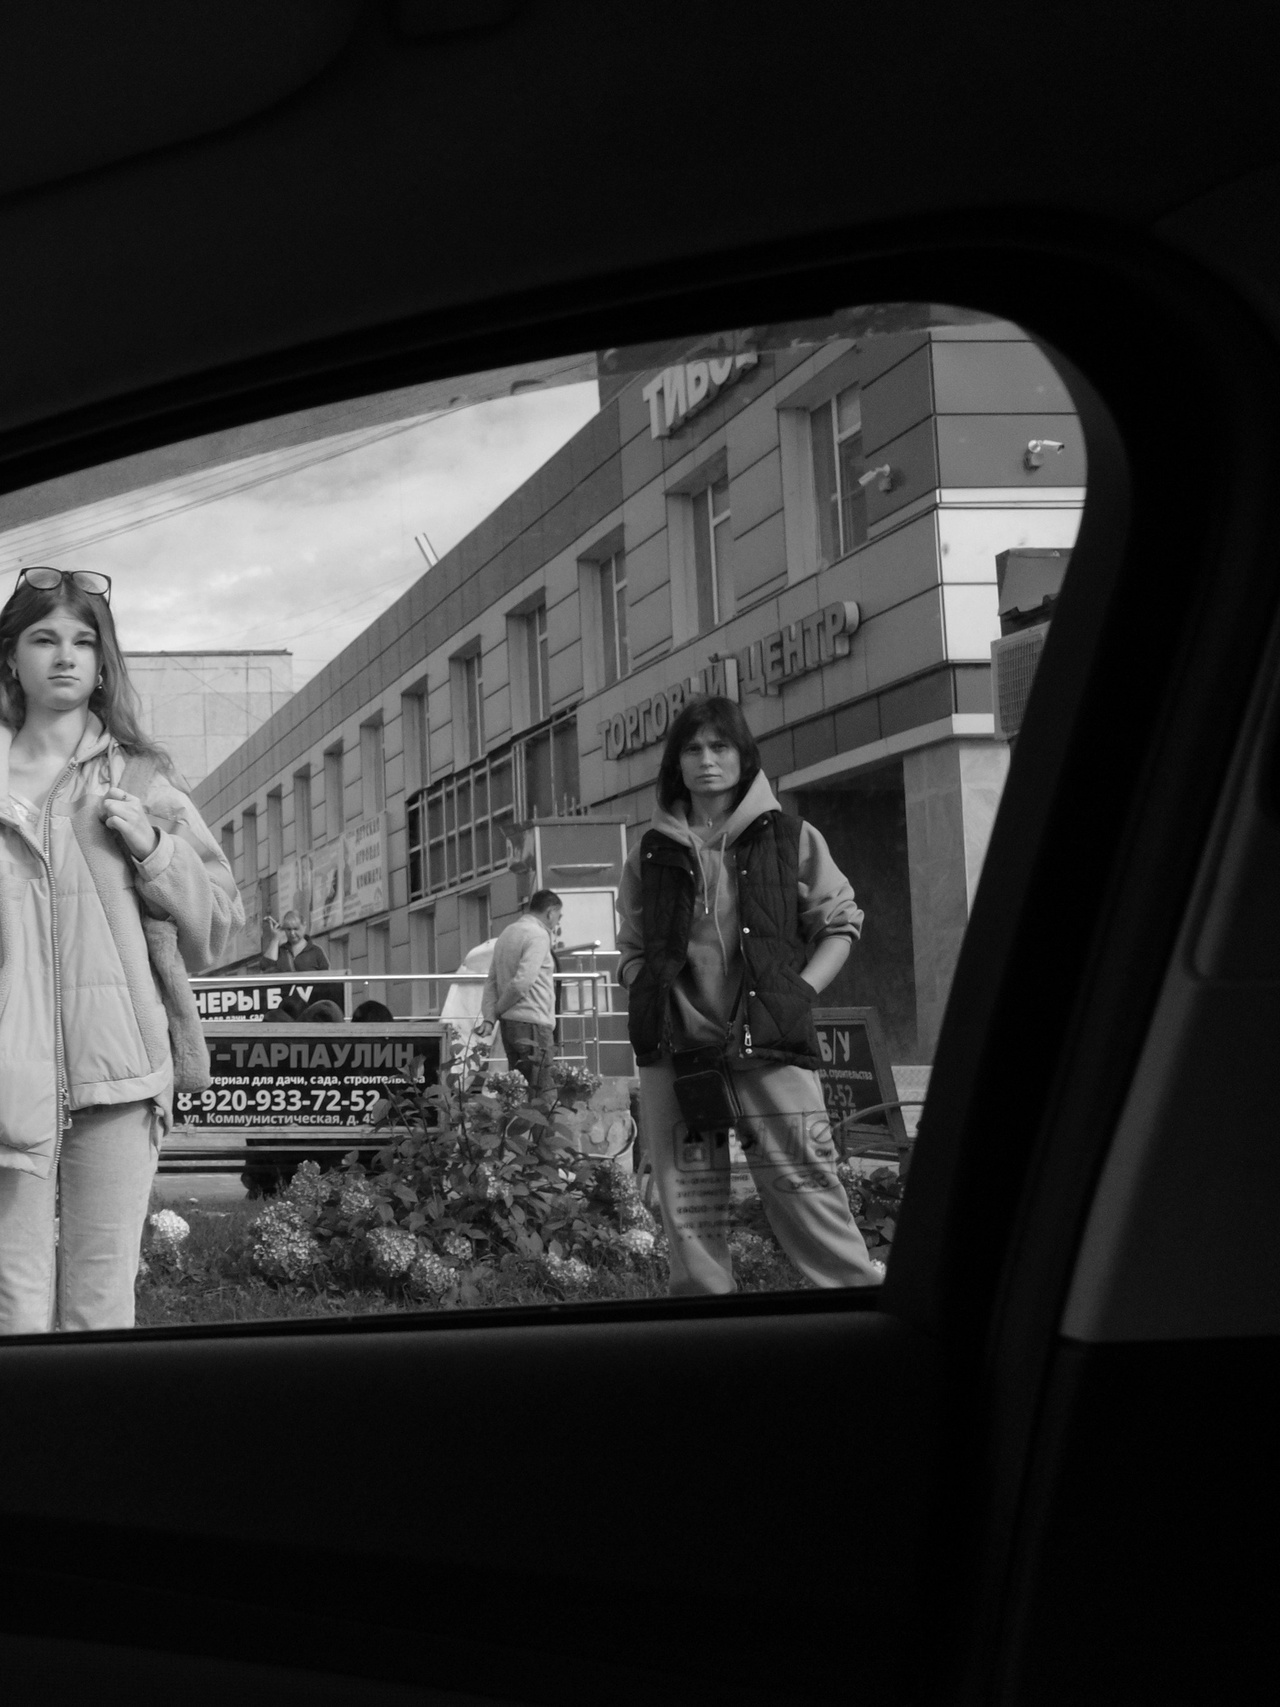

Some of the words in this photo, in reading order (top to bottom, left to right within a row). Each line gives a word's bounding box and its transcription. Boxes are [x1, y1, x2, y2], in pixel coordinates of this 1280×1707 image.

[742, 601, 860, 697] ЦЕНТР
[817, 1027, 851, 1066] Б/У
[251, 1075, 274, 1087] для
[275, 1075, 308, 1087] дачи,
[310, 1075, 342, 1087] сада,
[176, 1089, 381, 1112] 8-920-933-72-52
[183, 1114, 204, 1126] ул.
[206, 1113, 344, 1127] Коммунистическая,
[346, 1115, 360, 1126] д.
